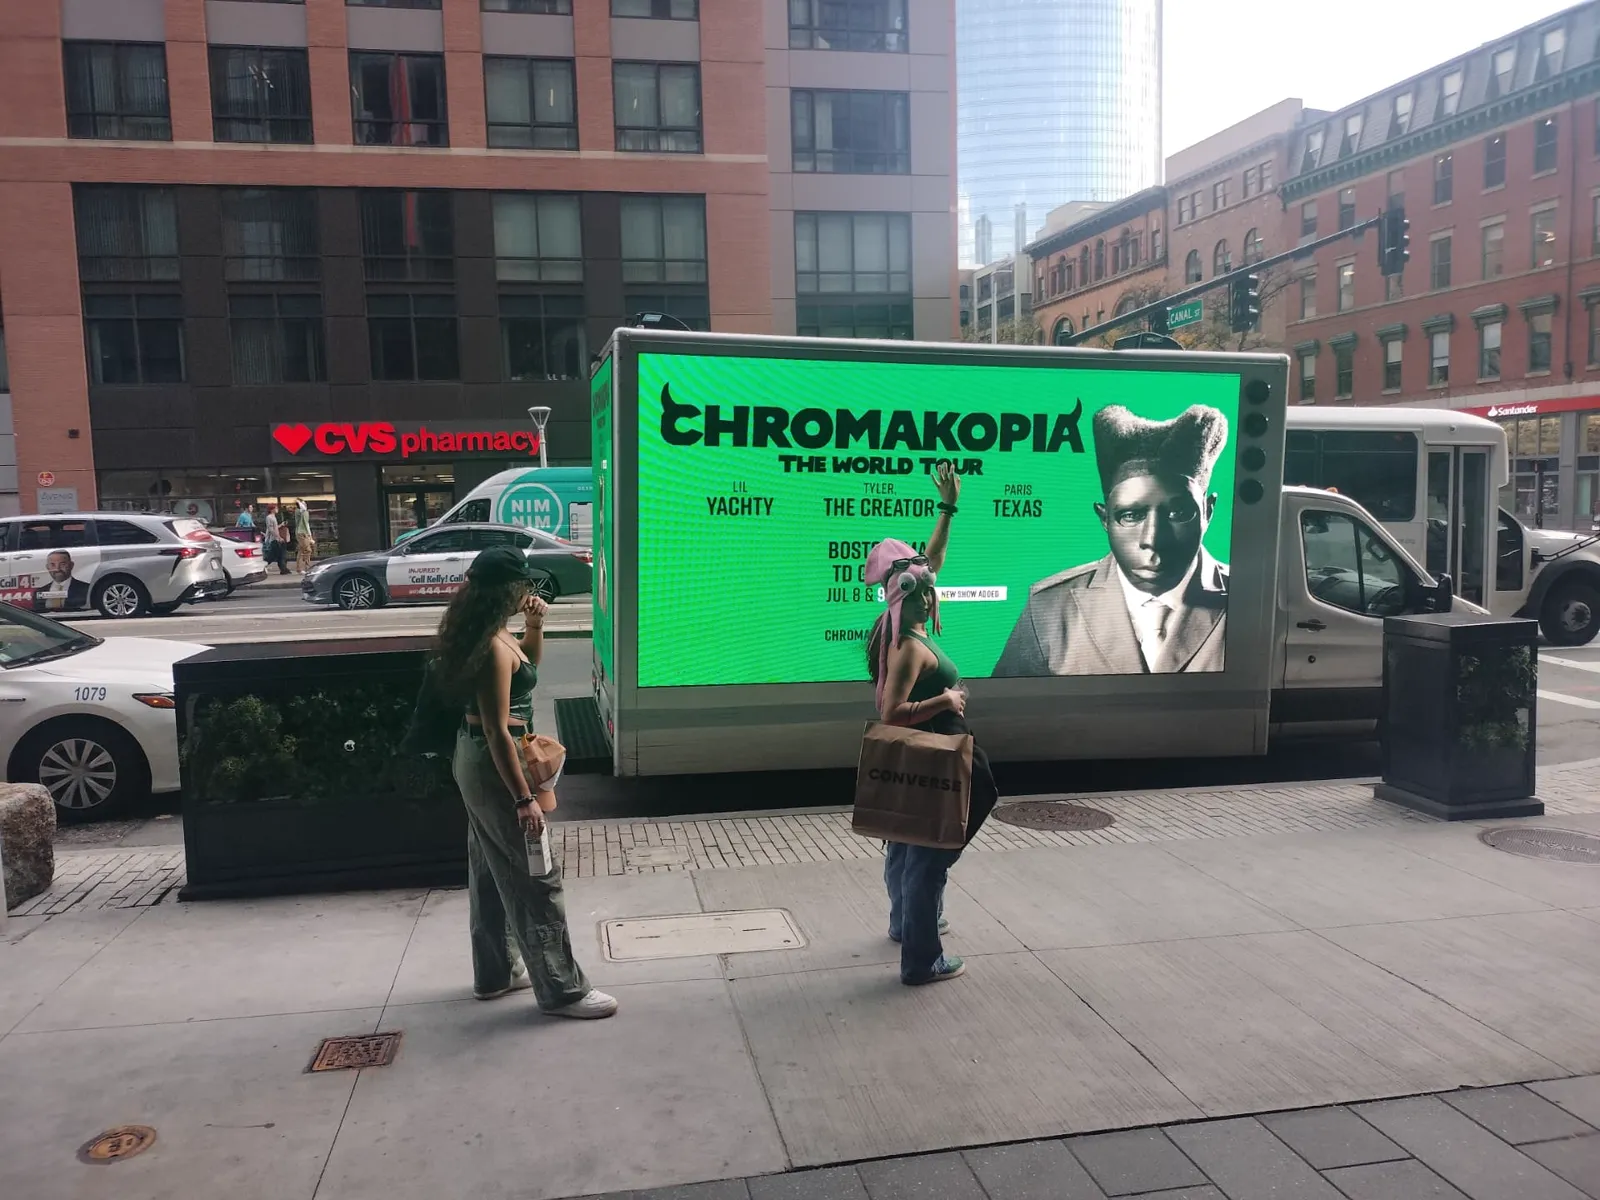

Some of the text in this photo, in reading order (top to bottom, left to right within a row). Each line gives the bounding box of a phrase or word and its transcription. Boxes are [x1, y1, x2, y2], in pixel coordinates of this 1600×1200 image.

[1170, 308, 1201, 324] CANAL ST
[660, 381, 1085, 453] CHROMAKOPIA
[1498, 405, 1538, 416] Santander
[314, 421, 541, 458] CVS pharmacy
[778, 454, 984, 476] THE WORLD TOUR
[733, 481, 748, 493] LIL
[864, 482, 897, 496] TYLER,
[1004, 484, 1032, 496] PARIS
[511, 499, 551, 513] NIM
[706, 497, 774, 516] YACHTY
[823, 498, 935, 517] THE CREATOR
[993, 499, 1042, 518] TEXAS
[511, 515, 551, 529] NIM
[829, 541, 880, 560] BOST
[427, 575, 448, 585] Kelly!
[449, 574, 463, 583] Call
[833, 565, 852, 583] TD
[826, 587, 886, 602] JUL 8 & 9
[941, 590, 999, 599] NEW SHOW ADDED
[824, 629, 870, 641] CHROMA
[74, 686, 107, 701] 1079
[868, 768, 962, 793] CONVERSE
